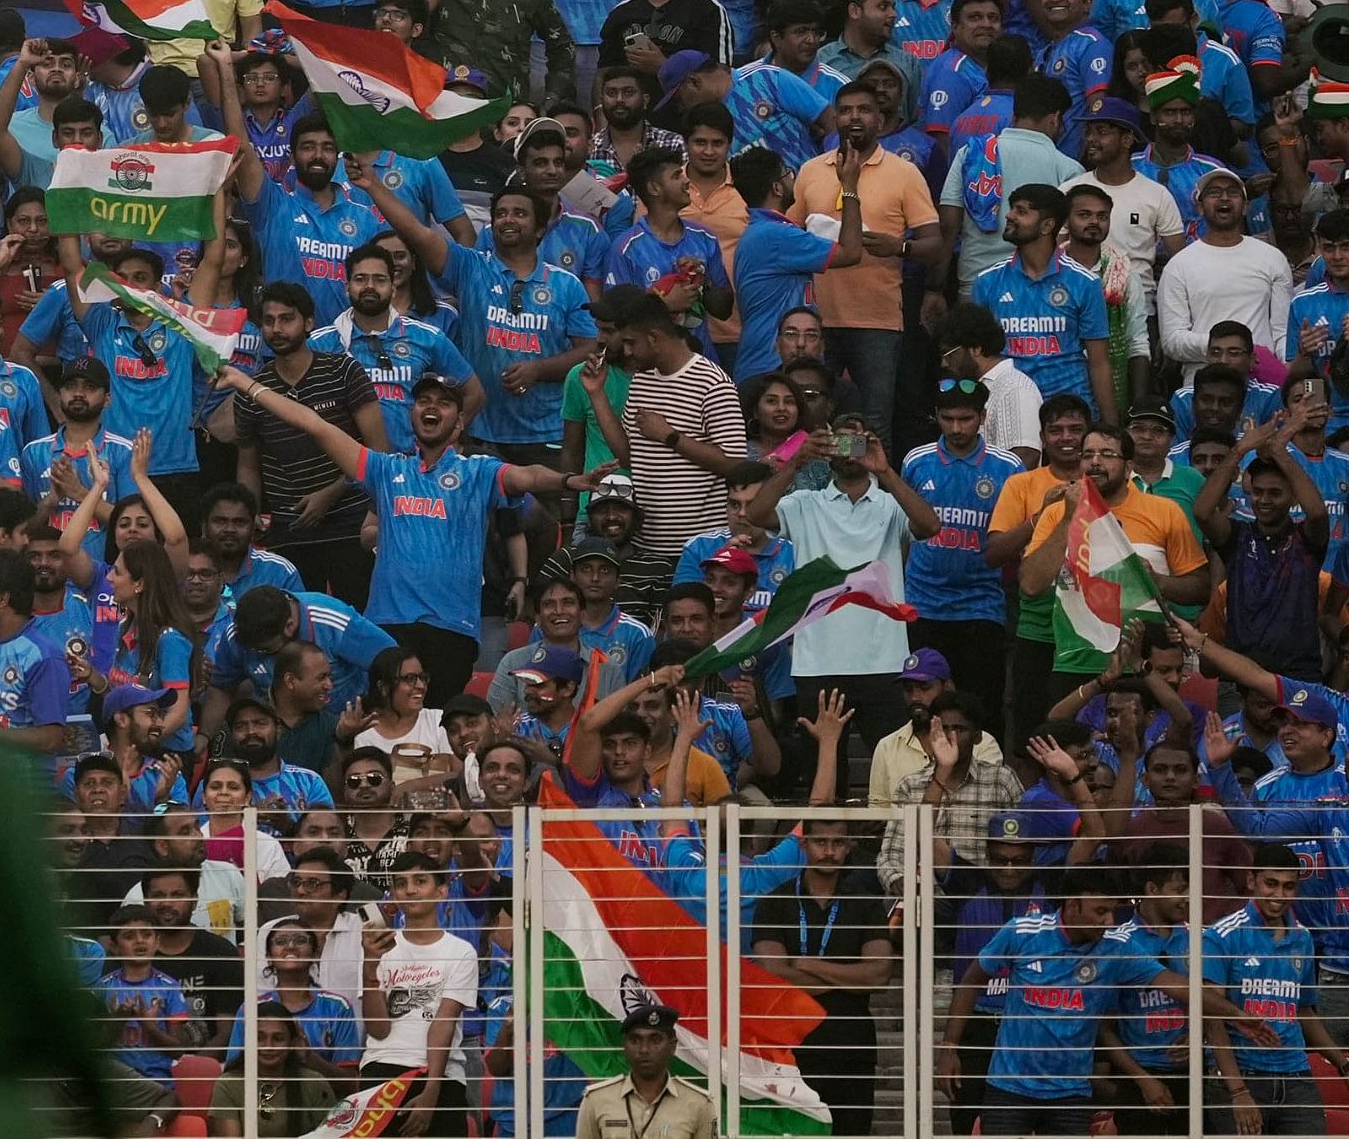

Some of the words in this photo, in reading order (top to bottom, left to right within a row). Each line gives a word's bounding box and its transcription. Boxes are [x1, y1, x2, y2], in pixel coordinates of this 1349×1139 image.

[90, 196, 165, 231] army
[487, 306, 548, 329] DREAM11
[1001, 317, 1066, 333] DREAM11
[487, 327, 540, 353] INDIA
[1008, 336, 1059, 355] INDIA
[116, 356, 168, 377] INDIA
[394, 496, 446, 518] INDIA
[385, 967, 439, 989] Motorcycles
[1024, 987, 1083, 1010] INDIA
[1245, 999, 1298, 1024] INDIA
